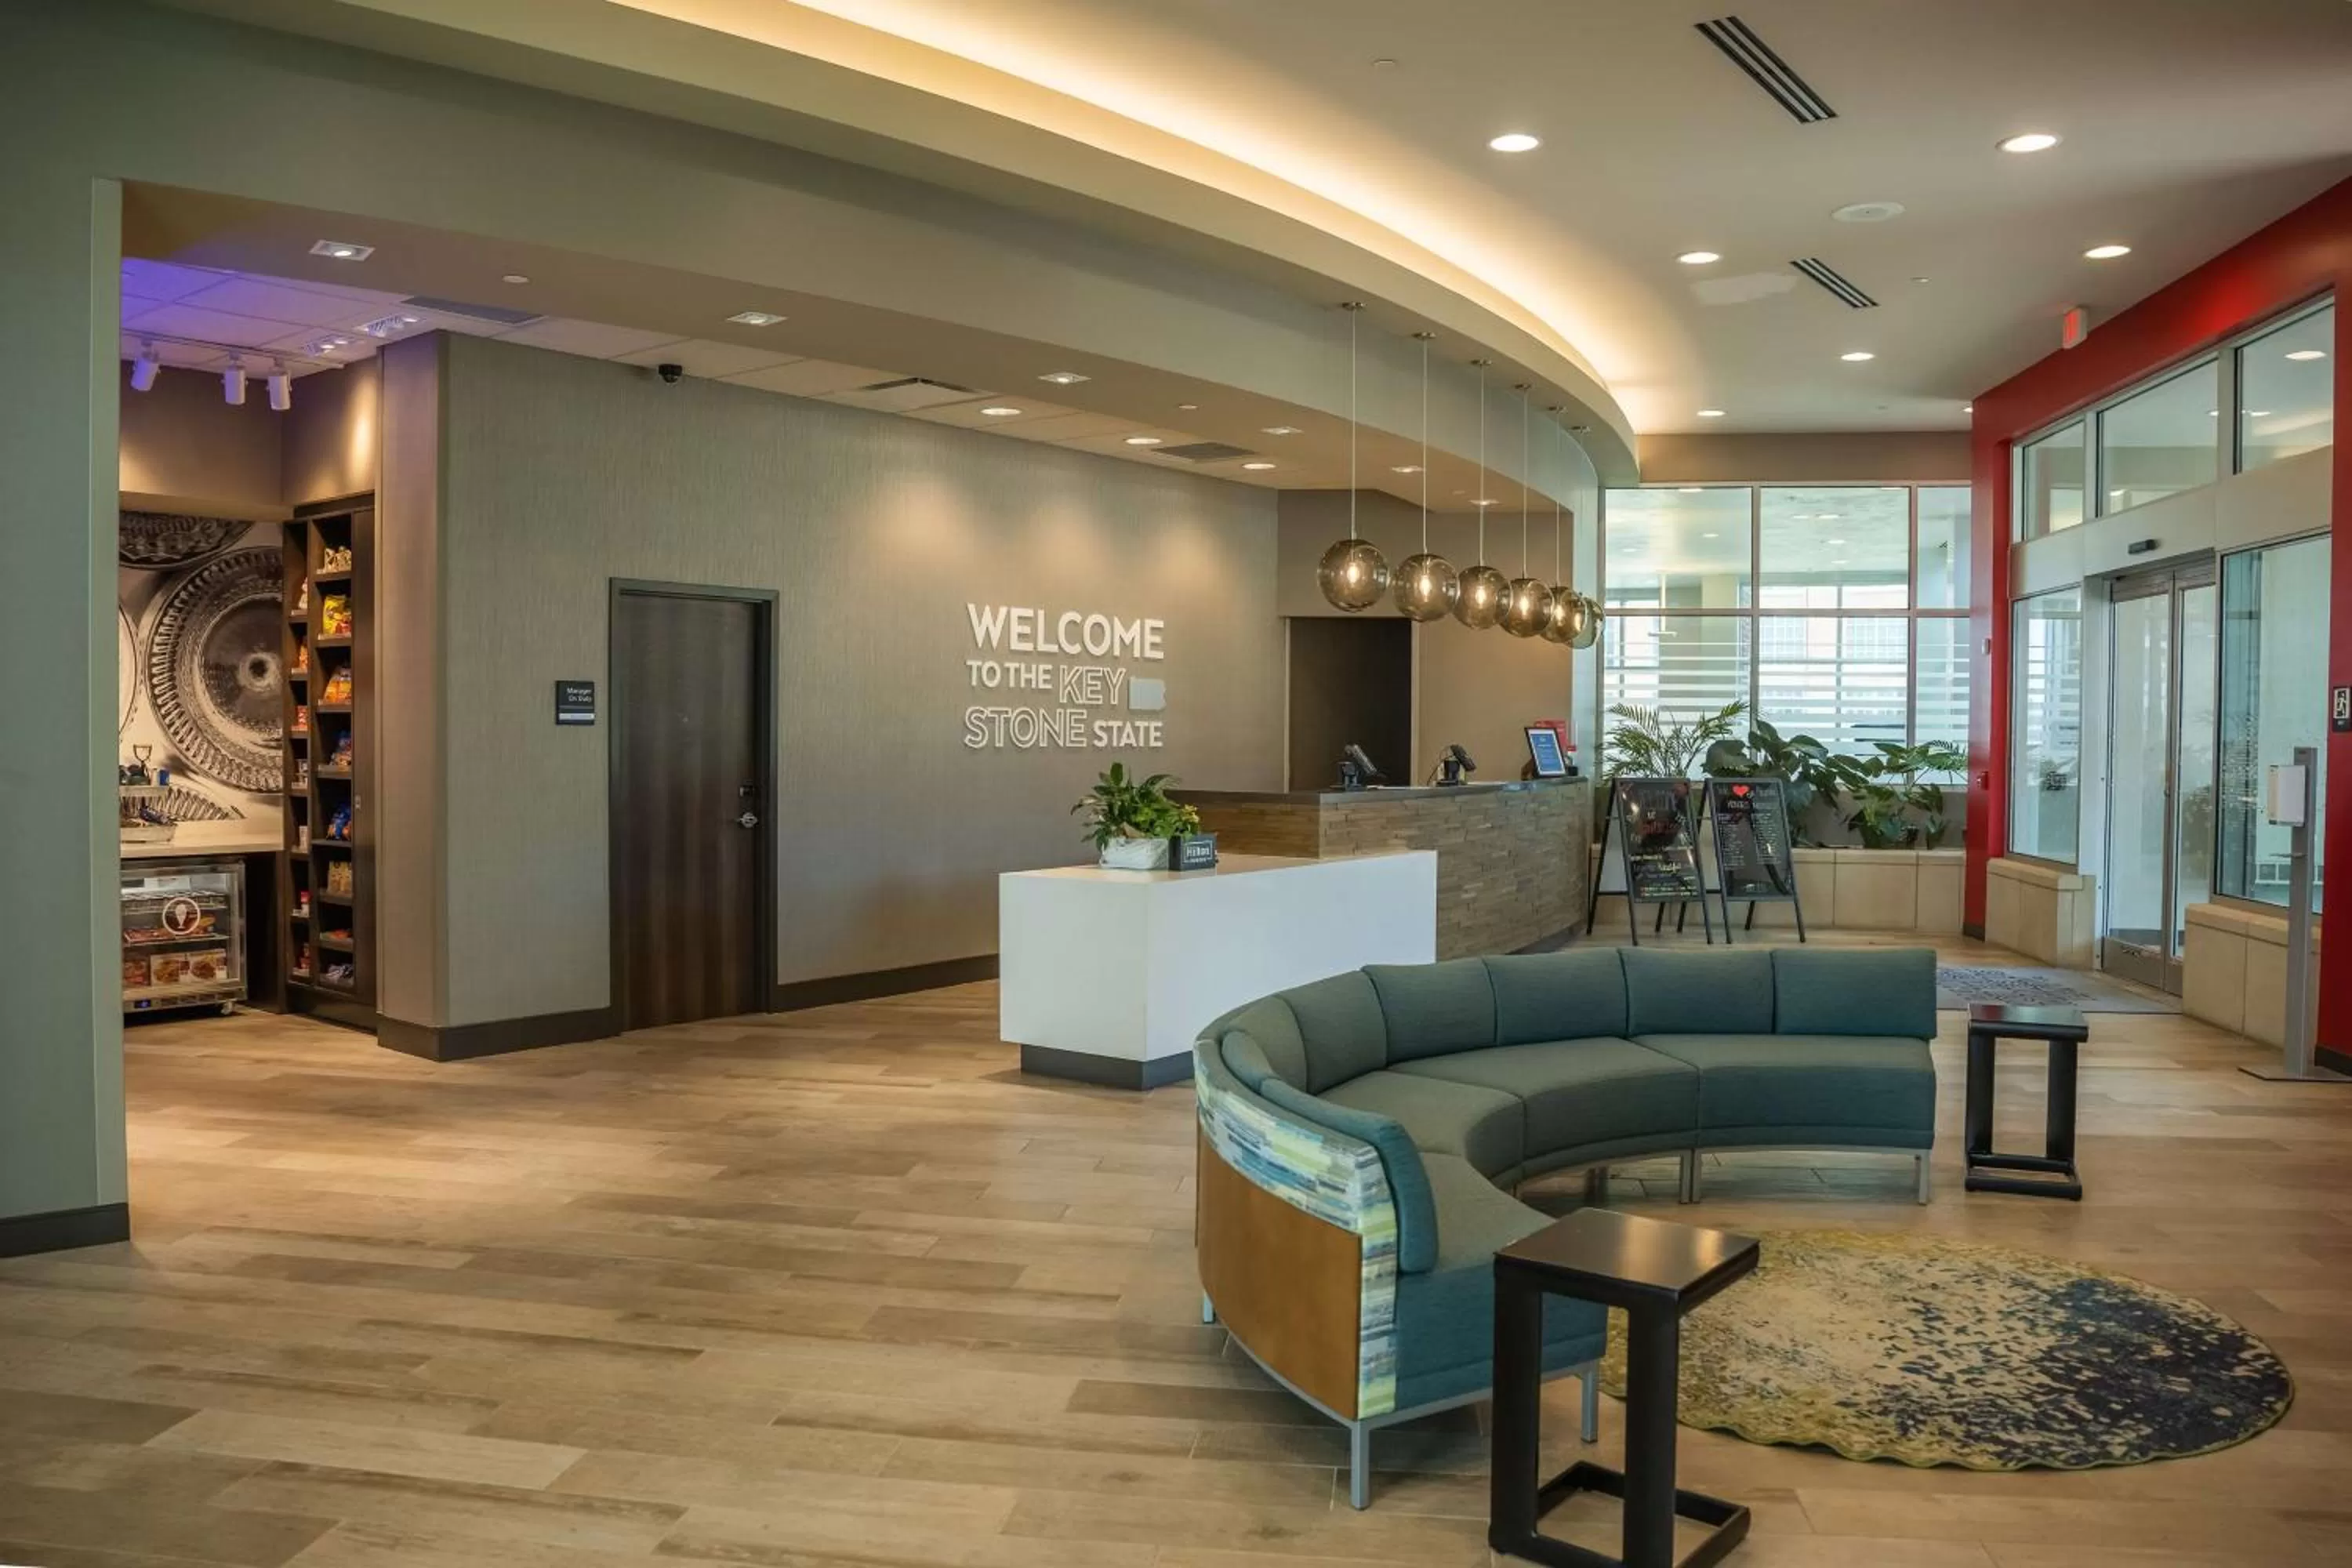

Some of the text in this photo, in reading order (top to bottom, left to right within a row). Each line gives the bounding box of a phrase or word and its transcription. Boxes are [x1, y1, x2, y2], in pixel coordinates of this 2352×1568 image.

[967, 603, 1164, 659] WELCOME
[966, 659, 1127, 705] TO THE KEY
[964, 706, 1163, 749] STONE STATE
